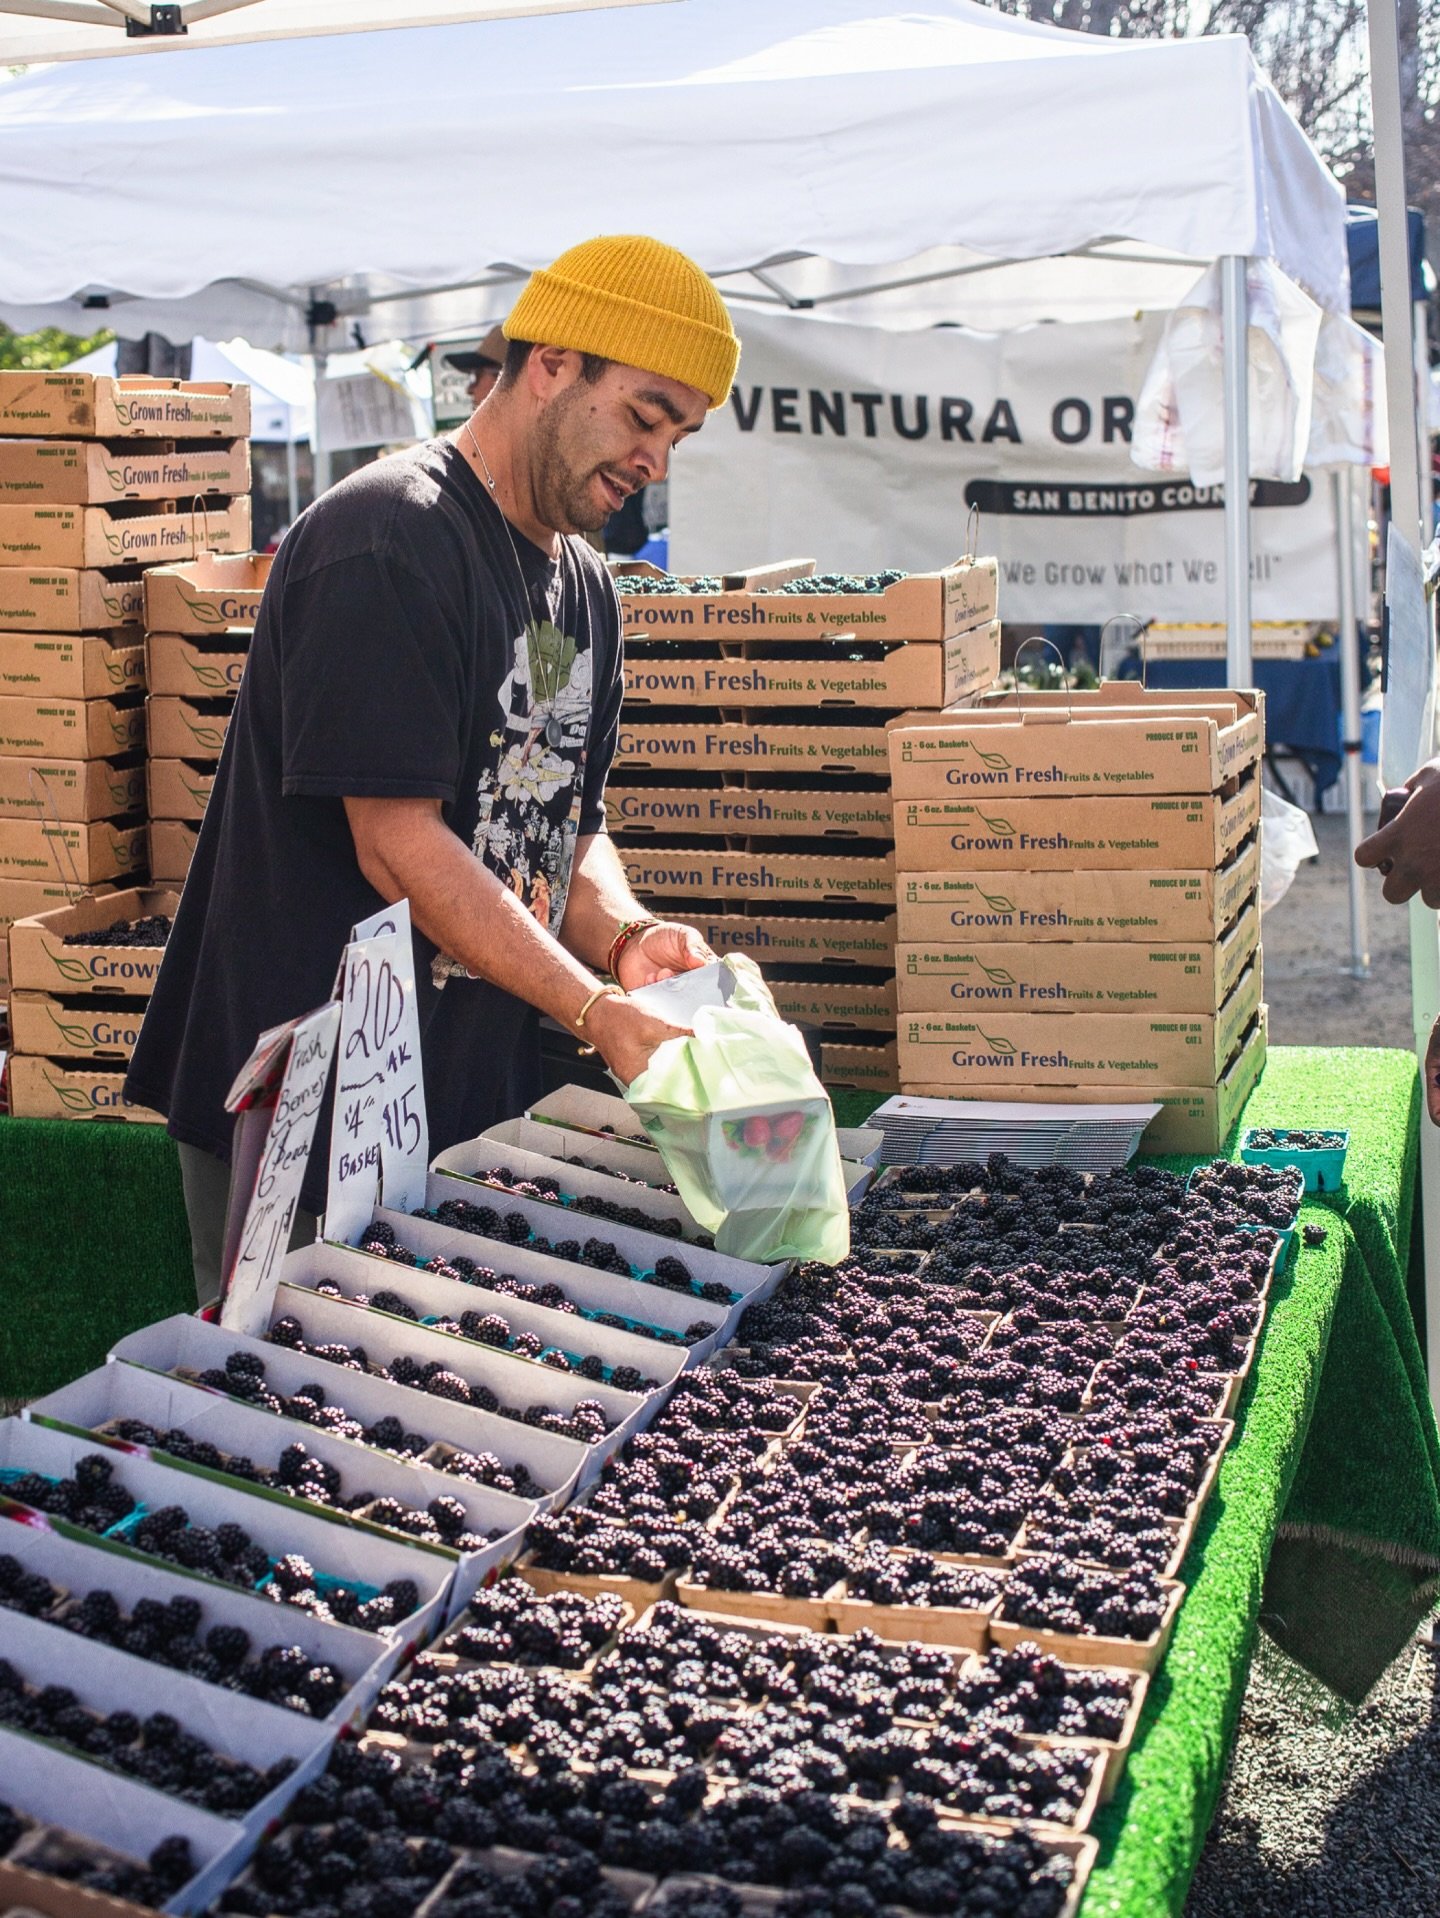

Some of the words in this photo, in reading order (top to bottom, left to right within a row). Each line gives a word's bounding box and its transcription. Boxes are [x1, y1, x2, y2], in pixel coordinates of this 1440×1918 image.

[11, 410, 50, 419] Vegetables
[130, 401, 162, 420] Grown
[166, 402, 190, 422] Fresh
[731, 385, 1022, 444] VENTURA
[124, 466, 158, 485] Grown
[163, 463, 188, 483] Fresh
[5, 481, 44, 490] Vegetables
[1013, 490, 1060, 509] SAN
[1069, 490, 1154, 510] BENITO
[1162, 482, 1255, 505] COUNY
[122, 530, 156, 549] Grown
[161, 525, 185, 545] Fresh
[2, 542, 41, 551] Vegetables
[1044, 561, 1105, 585] Grow
[1183, 559, 1217, 584] We
[0, 609, 36, 617] Vegetables
[221, 599, 260, 619] Gro
[622, 603, 694, 625] Grown
[703, 603, 765, 625] Fresh
[768, 612, 802, 624] Fruits
[806, 613, 816, 623] &
[820, 612, 887, 625] Vegetables
[3, 673, 40, 683] Vegetables
[623, 669, 695, 690] Grown
[705, 669, 766, 691] Fresh
[769, 679, 802, 691] Fruits
[807, 680, 816, 690] &
[821, 679, 887, 692] Vegetables
[1146, 733, 1174, 741] PRODUCE
[1176, 732, 1183, 740] OF
[1186, 732, 1197, 740] USA
[7, 738, 44, 747] Vegetables
[618, 733, 696, 754] Grown
[705, 734, 768, 755] Fresh
[770, 745, 803, 756] Fruits
[807, 746, 817, 756] &
[821, 745, 887, 758] Vegetables
[939, 740, 968, 748] Baskets
[1182, 744, 1193, 752] CAT
[946, 769, 1008, 784] Grown
[1016, 765, 1063, 783] Fresh
[1064, 773, 1090, 782] Fruits
[1093, 773, 1100, 781] &
[1104, 771, 1154, 783] Vegetables
[7, 797, 44, 807] Vegetables
[1152, 802, 1179, 810] PRODUCE
[621, 797, 700, 818] Grown
[709, 798, 772, 820] Fresh
[773, 810, 807, 821] Fruits
[811, 811, 821, 821] &
[825, 811, 891, 823] Vegetables
[944, 805, 974, 813] Baskets
[1187, 814, 1198, 822] CAT
[951, 834, 1013, 850] Grown
[1020, 833, 1068, 850] Fresh
[1069, 840, 1094, 848] Fruits
[1098, 840, 1105, 848] &
[1108, 839, 1159, 850] Vegetables
[12, 857, 48, 867] Vegetables
[625, 864, 703, 885] Grown
[712, 866, 774, 887] Fresh
[775, 877, 809, 889] Fruits
[813, 878, 822, 889] &
[827, 878, 893, 891] Vegetables
[944, 882, 974, 890] Baskets
[1180, 879, 1187, 887] OF
[1189, 879, 1200, 887] USA
[1185, 892, 1196, 900] CAT
[951, 911, 1012, 926] Grown
[1020, 909, 1067, 925] Fresh
[1069, 917, 1093, 926] Fruits
[1097, 918, 1104, 926] &
[1107, 916, 1158, 928] Vegetables
[707, 926, 769, 946] Fresh
[772, 937, 805, 948] Fruits
[809, 938, 818, 949] &
[822, 938, 888, 951] Vegetables
[944, 954, 974, 962] Baskets
[1179, 953, 1187, 961] OF
[1189, 953, 1200, 961] USA
[90, 956, 160, 978] Grow
[1185, 966, 1195, 974] CAT
[951, 983, 1012, 998] Grown
[1020, 983, 1066, 998] Fresh
[1068, 991, 1093, 999] Fruits
[1096, 991, 1103, 999] &
[1107, 990, 1157, 1001] Vegetables
[810, 1003, 819, 1014] &
[824, 1003, 890, 1016] Vegetables
[946, 1023, 976, 1031] Baskets
[1151, 1024, 1178, 1032] PRODUCE
[93, 1023, 138, 1044] Gro
[1186, 1036, 1196, 1044] CAT
[952, 1051, 1014, 1067] Grown
[1021, 1051, 1068, 1067] Fresh
[1069, 1060, 1094, 1069] Fruits
[1098, 1060, 1105, 1069] &
[1108, 1060, 1158, 1071] Vegetables
[825, 1063, 890, 1077] Vegetables
